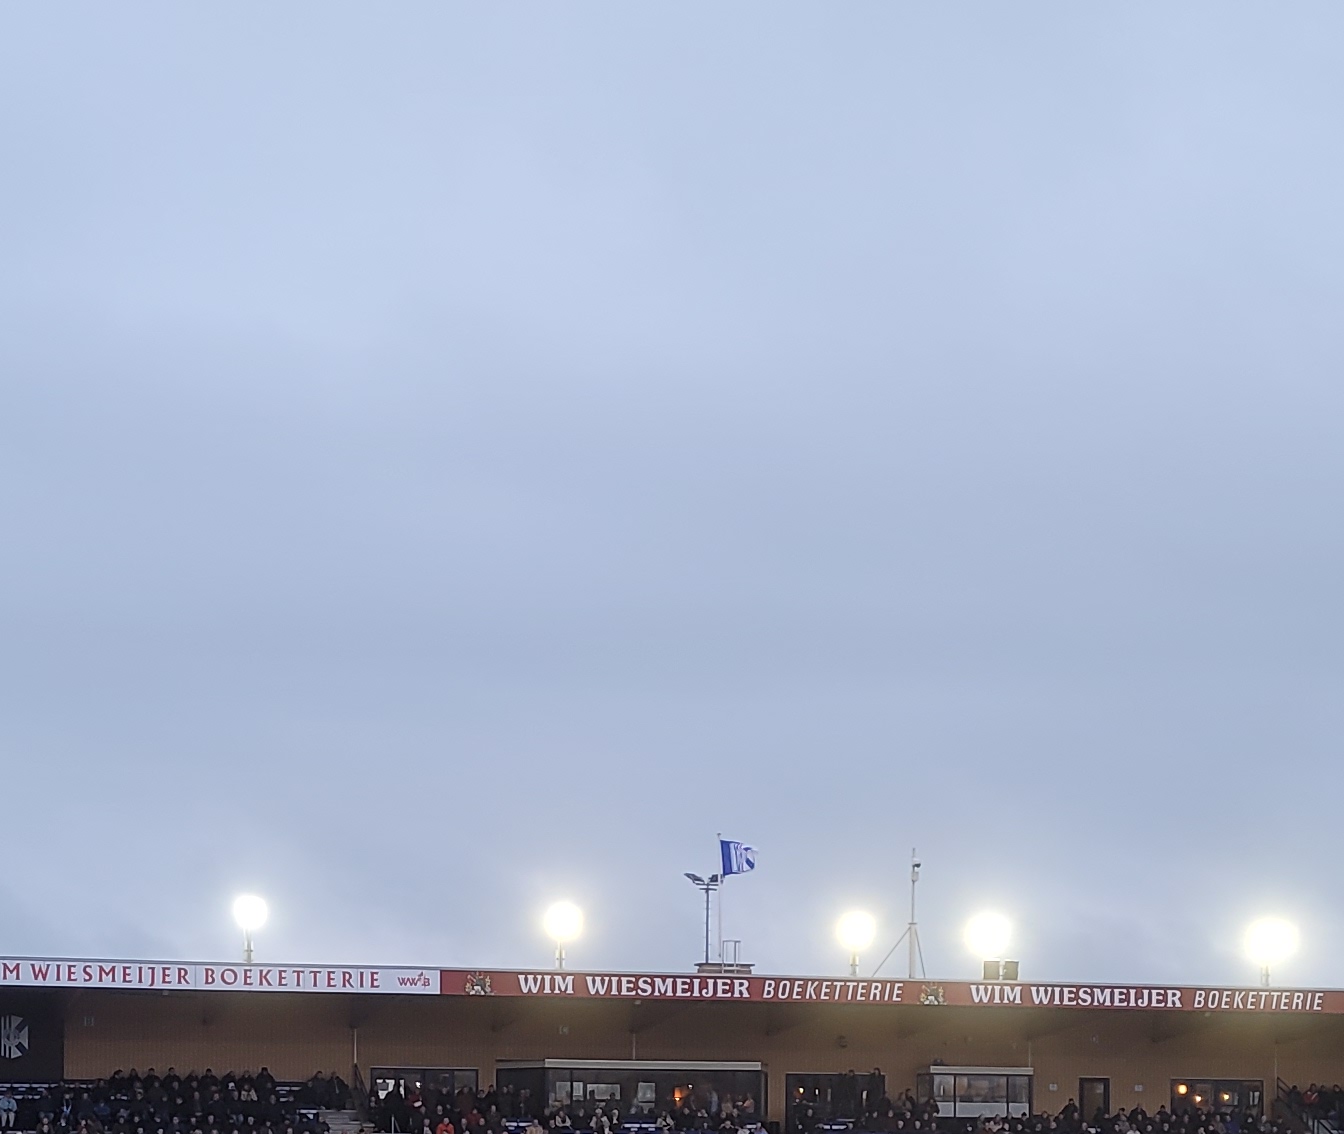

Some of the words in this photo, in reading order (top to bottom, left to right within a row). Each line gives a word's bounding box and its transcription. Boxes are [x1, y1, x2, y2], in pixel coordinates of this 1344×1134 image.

[30, 963, 191, 987] WIESMEIJER
[204, 967, 381, 989] BOEKETTERIE
[518, 974, 575, 995] WIM
[585, 976, 751, 998] WIESMEIJER
[762, 980, 905, 1002] BOEKETTERIE
[969, 984, 1023, 1005] WIM
[1031, 986, 1183, 1008] WIESMEIJER
[1193, 989, 1324, 1011] BOEKETTERIE
